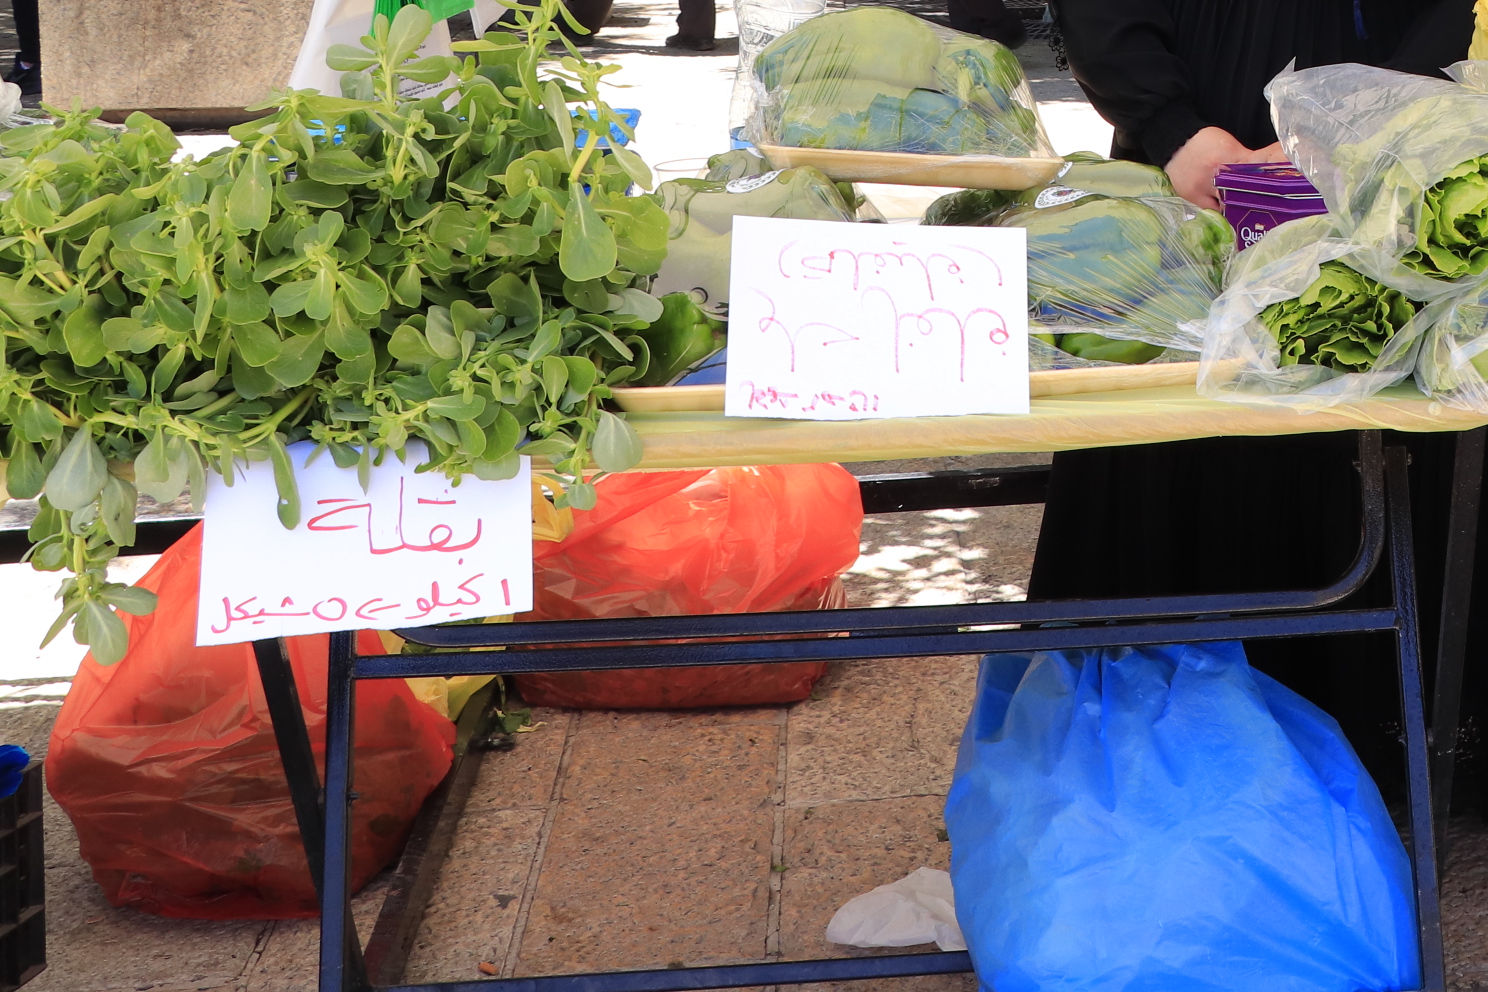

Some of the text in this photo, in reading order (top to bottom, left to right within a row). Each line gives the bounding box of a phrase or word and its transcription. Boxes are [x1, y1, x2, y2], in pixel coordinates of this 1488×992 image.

[306, 476, 483, 566] بقلة
[210, 596, 312, 635] شيكل
[404, 572, 486, 620] كيلو
